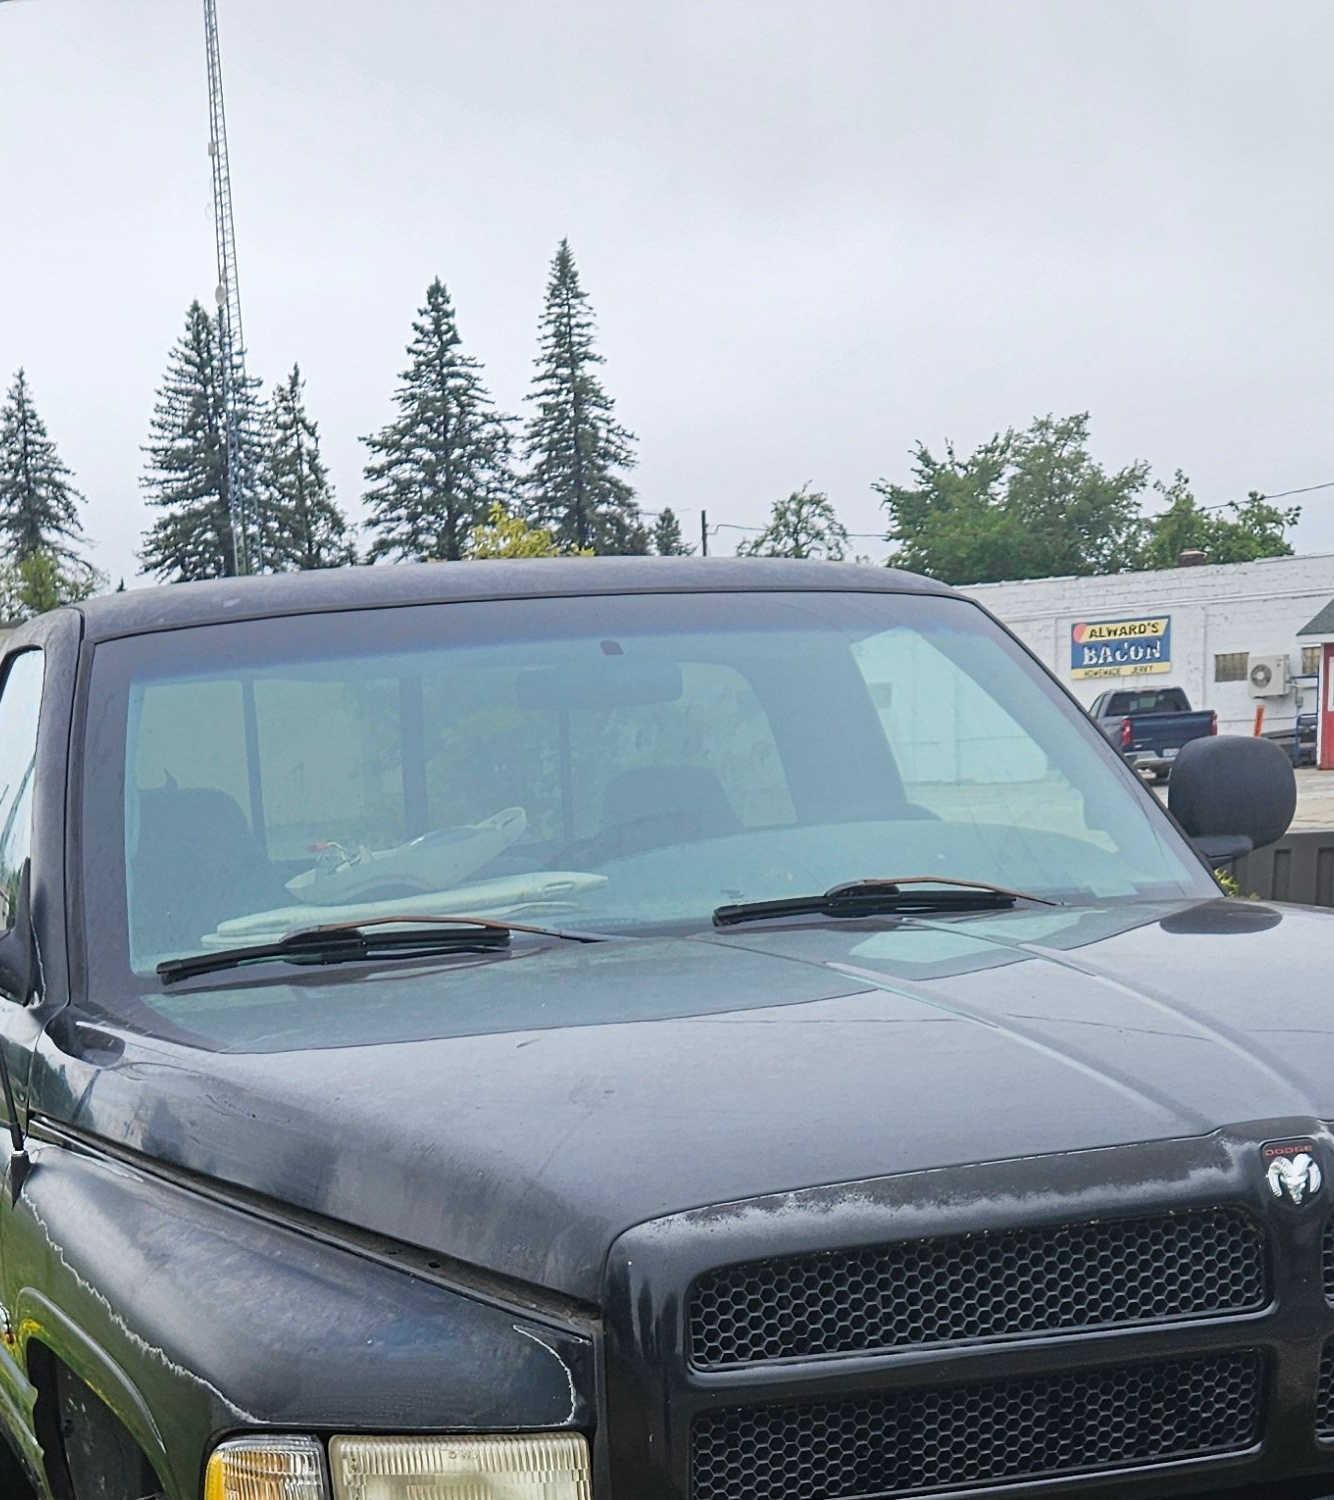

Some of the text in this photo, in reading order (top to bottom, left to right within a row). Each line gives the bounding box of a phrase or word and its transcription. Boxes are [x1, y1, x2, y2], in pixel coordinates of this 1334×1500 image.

[1088, 622, 1159, 639] ALWARD'S
[1082, 640, 1161, 665] BACON
[1084, 668, 1121, 677] HOMEMADE
[1265, 1145, 1313, 1156] DODGE
